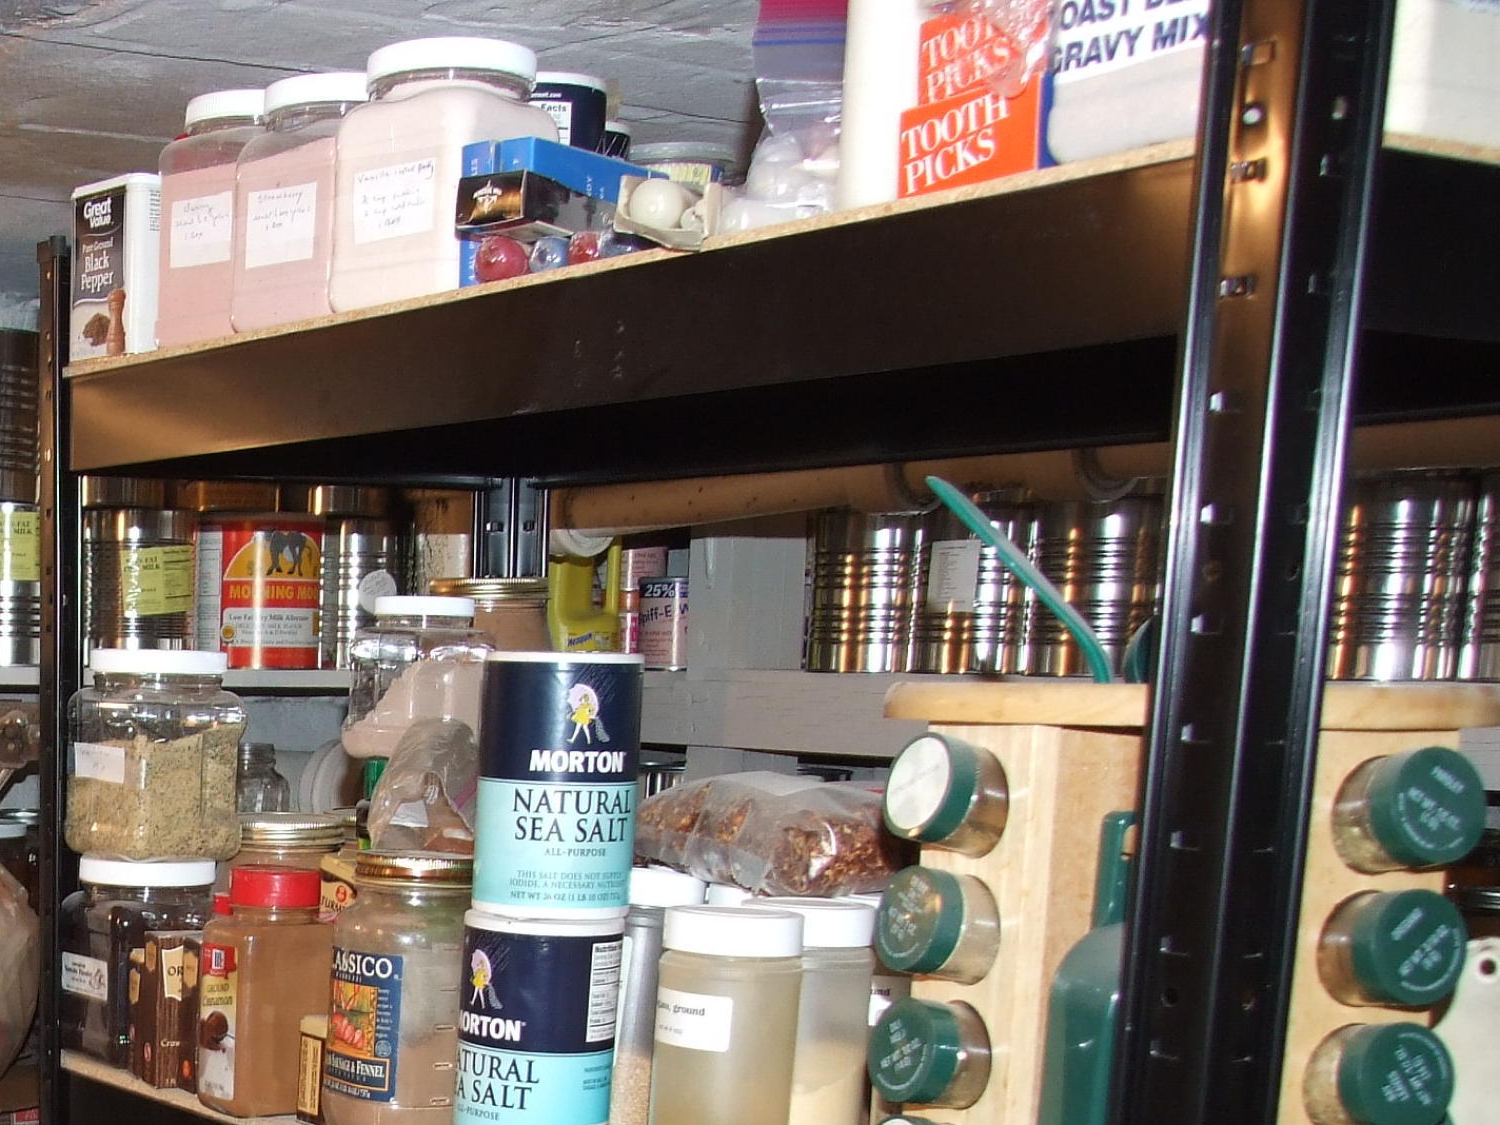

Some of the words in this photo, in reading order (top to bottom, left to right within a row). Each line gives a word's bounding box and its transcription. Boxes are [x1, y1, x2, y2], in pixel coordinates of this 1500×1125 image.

[1059, 0, 1132, 30] OAST
[902, 92, 1010, 160] TOOTH
[904, 127, 995, 196] PICKS
[84, 197, 112, 219] Great
[89, 215, 112, 229] Value
[84, 250, 110, 272] Black
[81, 271, 114, 293] Pepper
[644, 583, 676, 598] 25%
[529, 749, 625, 773] MORTON
[513, 788, 632, 815] NATURAL
[514, 816, 565, 842] SEA
[575, 817, 628, 843] SALT
[544, 848, 607, 858] ALL-PURPOSE
[516, 870, 537, 879] THIS
[539, 871, 559, 880] SALT
[560, 871, 582, 880] DOES
[672, 1004, 706, 1017] ground
[356, 1060, 385, 1078] FENNEL
[472, 1080, 533, 1110] SALT
